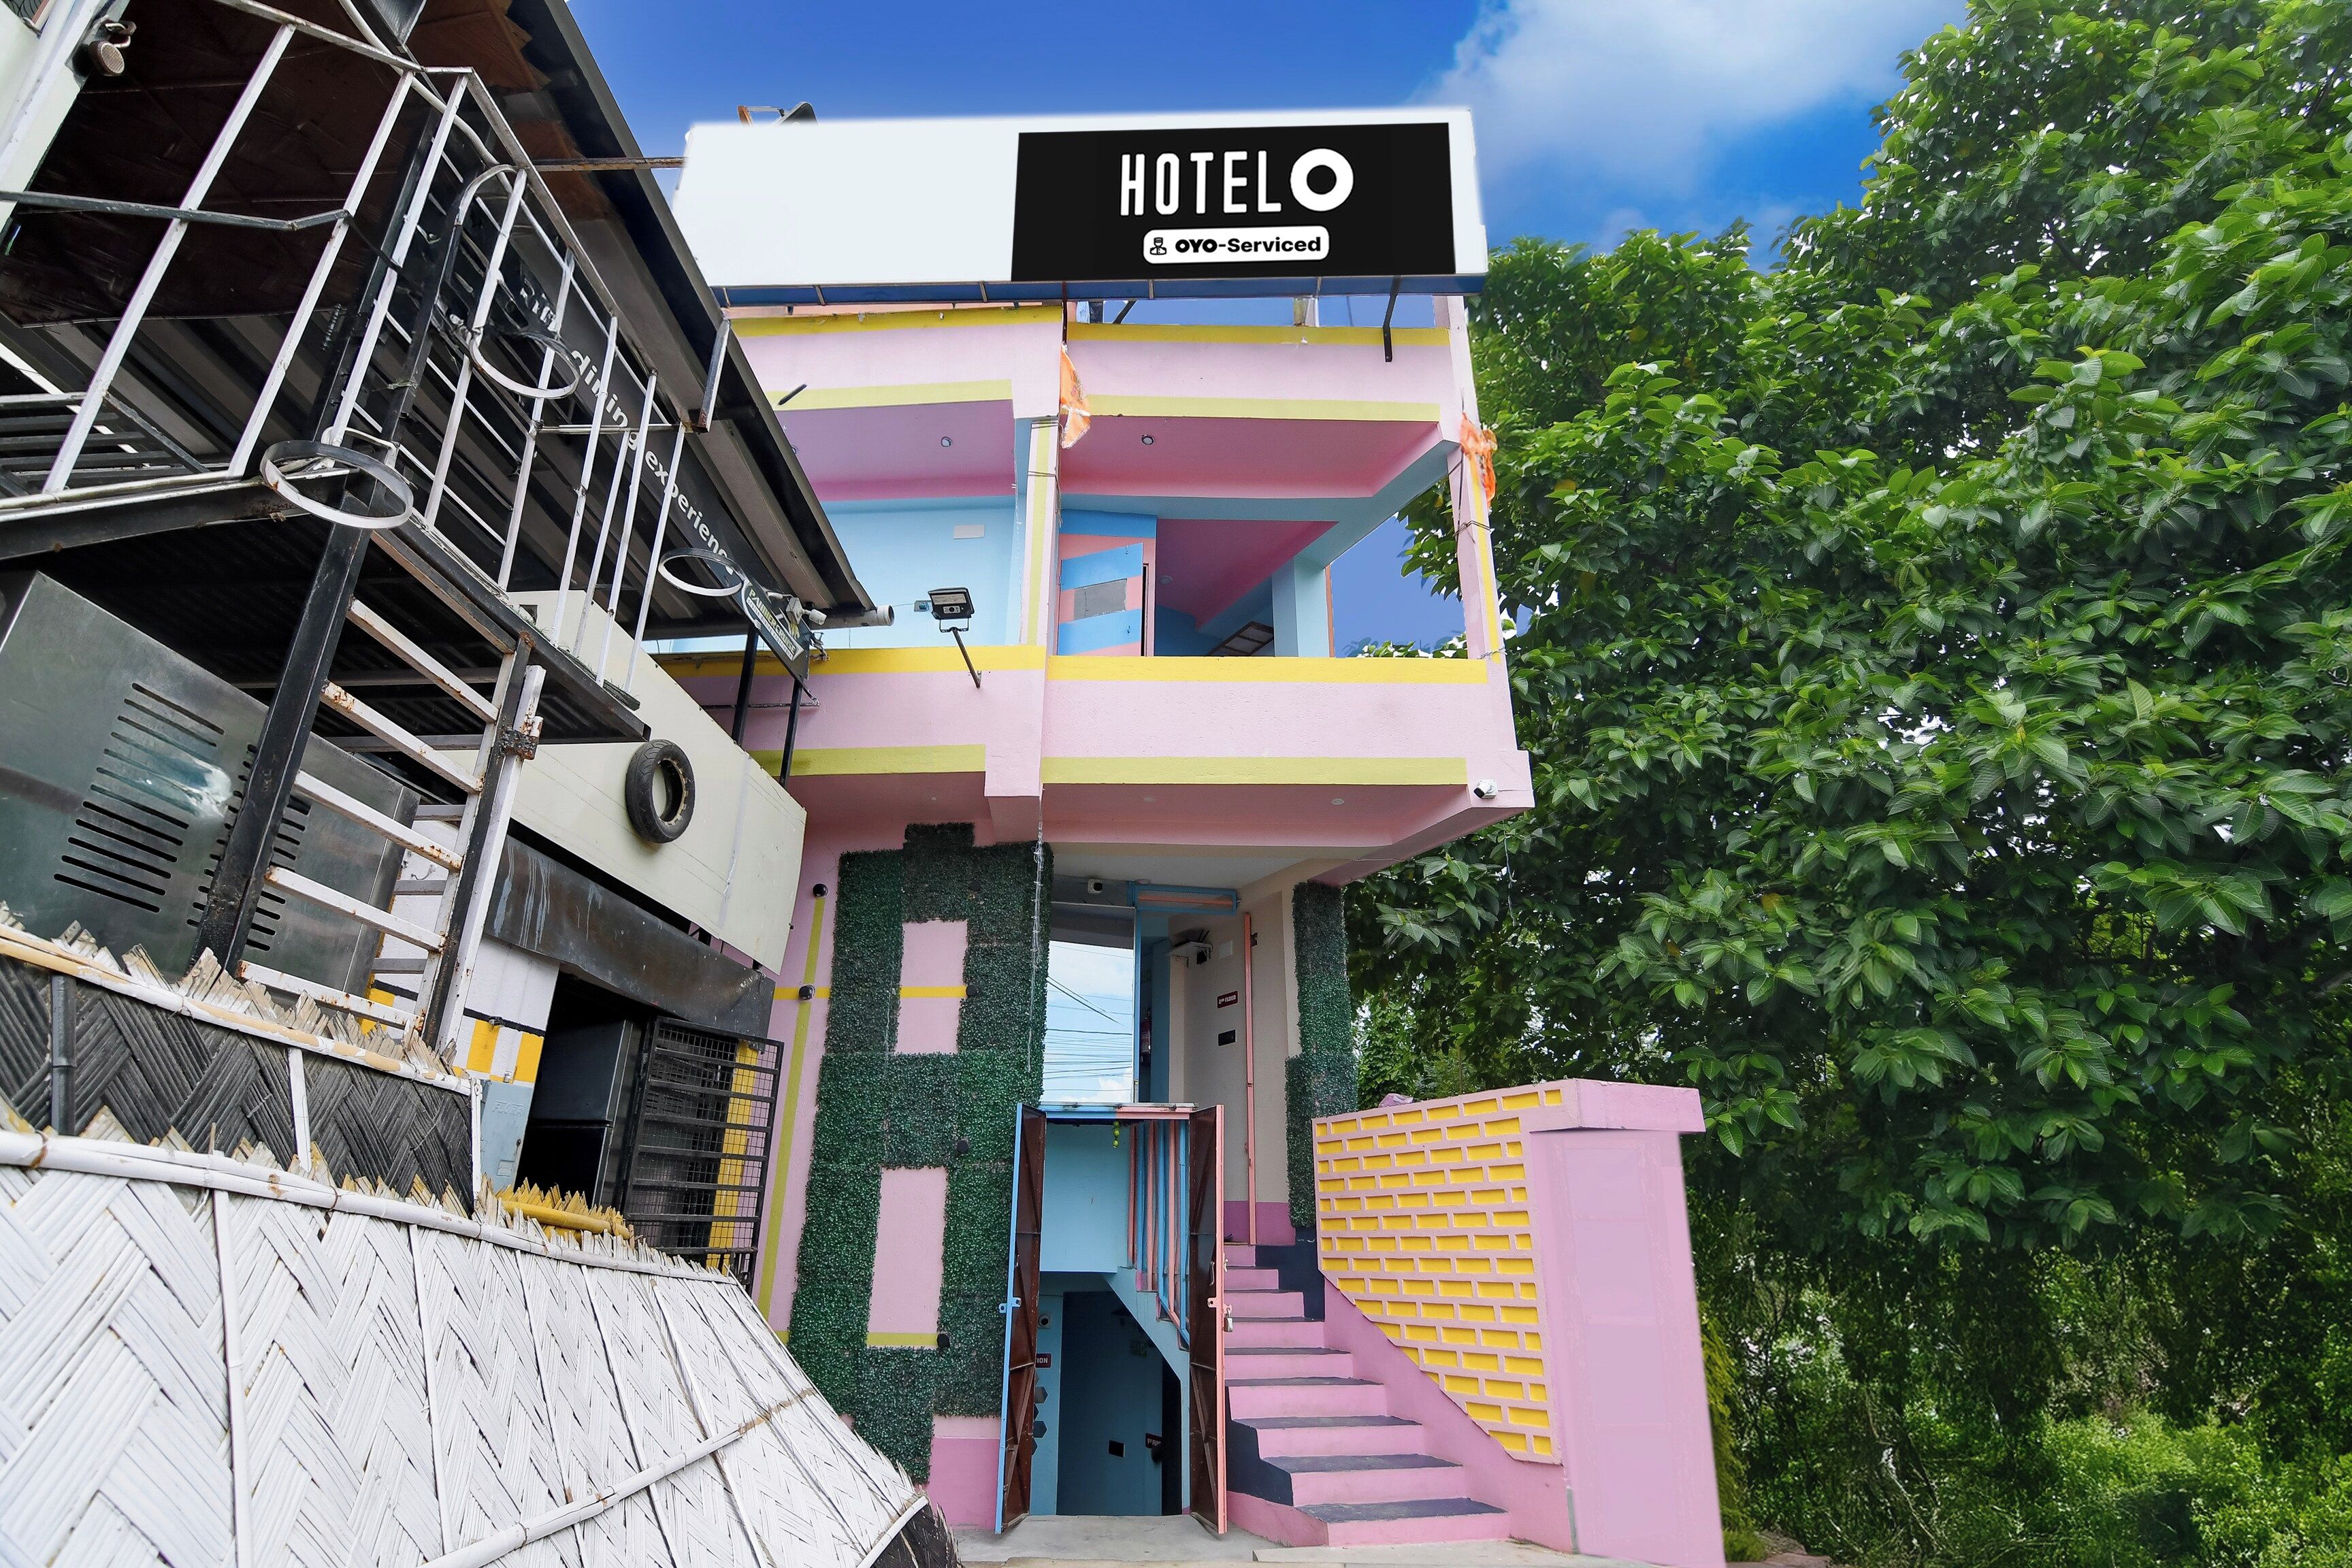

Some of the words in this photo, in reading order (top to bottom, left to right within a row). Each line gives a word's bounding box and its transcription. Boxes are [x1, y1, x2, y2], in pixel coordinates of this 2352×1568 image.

[1120, 150, 1281, 216] HOTEL
[1175, 236, 1322, 254] OYO-Serviced
[645, 450, 734, 576] experienc
